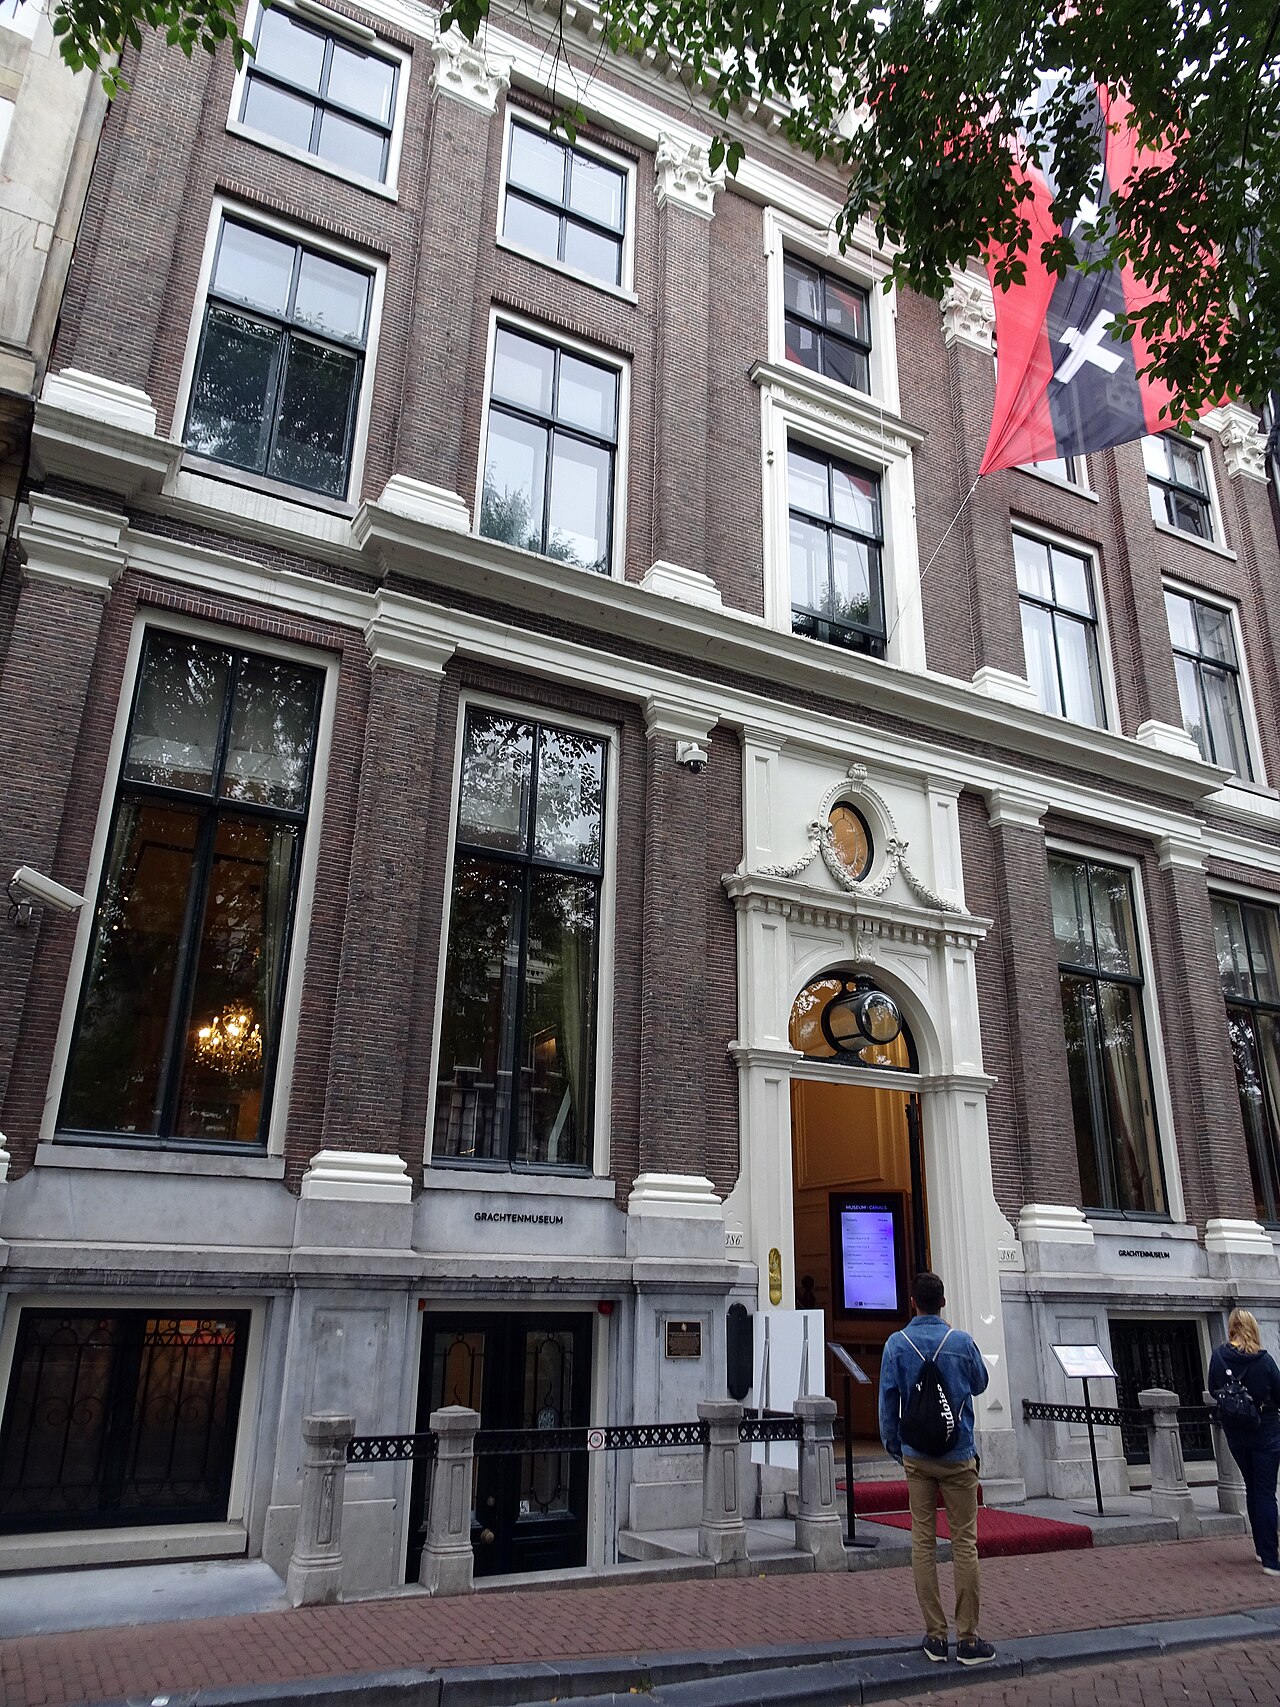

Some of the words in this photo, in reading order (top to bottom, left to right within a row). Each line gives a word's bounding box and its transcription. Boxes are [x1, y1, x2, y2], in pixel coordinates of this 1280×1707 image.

[474, 1212, 564, 1224] GRACHTENMUSEUM
[725, 1233, 743, 1246] 386
[1000, 1249, 1016, 1260] 386
[1118, 1249, 1170, 1259] GRACHTENMUSEUM
